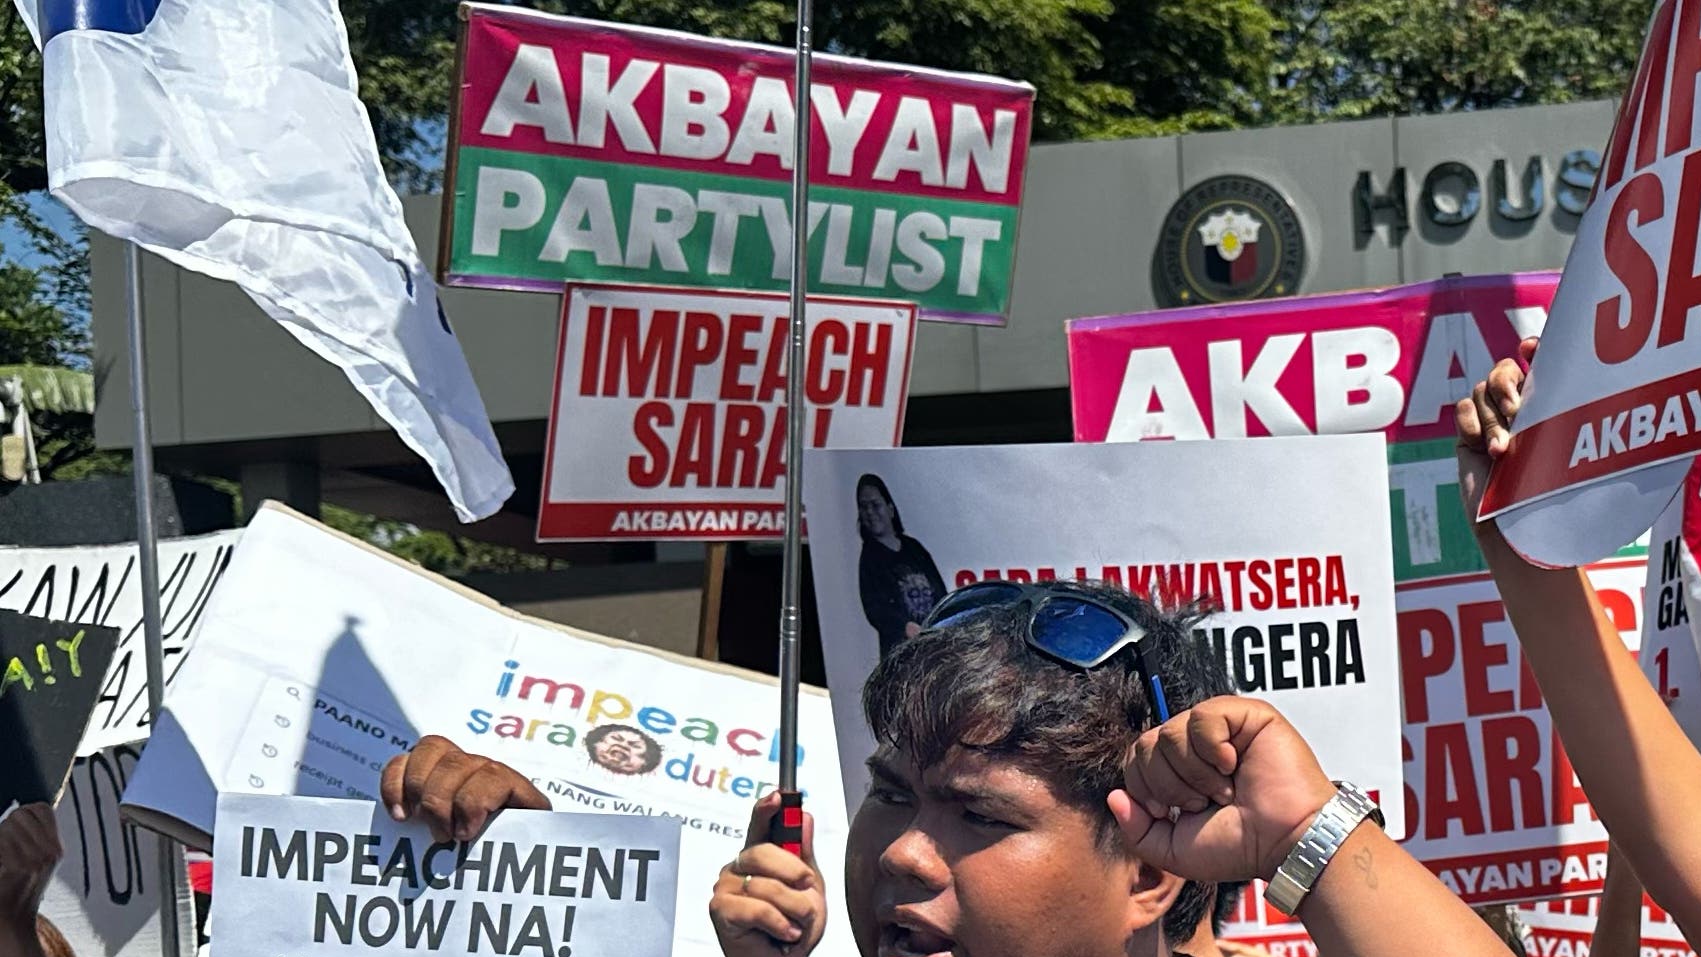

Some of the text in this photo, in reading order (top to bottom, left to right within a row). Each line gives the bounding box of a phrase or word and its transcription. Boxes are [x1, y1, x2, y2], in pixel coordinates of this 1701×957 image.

[481, 43, 1017, 194] AKBAYAN
[470, 165, 1002, 297] PARTYLIST
[1352, 149, 1601, 238] HOUS
[579, 305, 893, 408] IMPEACH
[1104, 307, 1550, 443] AKBA
[610, 510, 808, 533] AKBAYAN PAR
[1077, 555, 1360, 613] AKWATSERA,
[314, 698, 386, 739] PAANO
[496, 659, 806, 763] impeach
[466, 708, 809, 804] sara duter
[547, 781, 606, 810] NANG
[709, 823, 744, 840] RES
[241, 826, 661, 902] IMPEACHMENT
[1436, 852, 1608, 897] AYAN PAR
[314, 892, 455, 951] NOW
